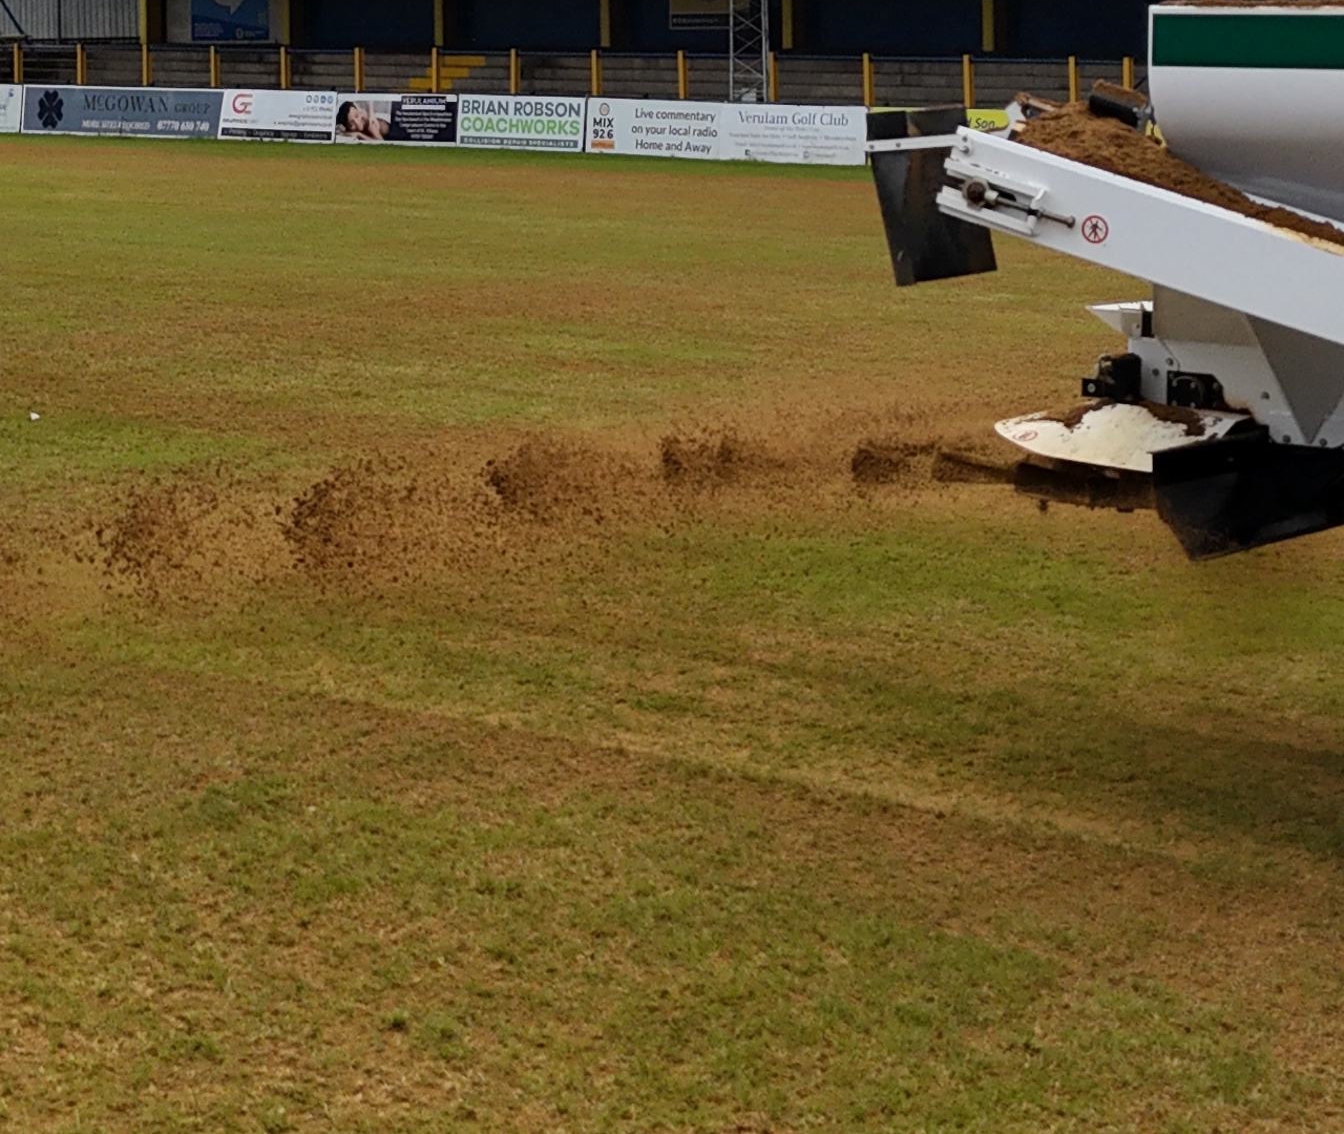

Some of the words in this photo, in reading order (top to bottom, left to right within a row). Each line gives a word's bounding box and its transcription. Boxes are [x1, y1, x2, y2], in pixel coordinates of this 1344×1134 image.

[83, 94, 169, 113] McGOWAN
[461, 100, 509, 116] BRIAN
[514, 101, 581, 118] ROBSON
[593, 117, 614, 129] MIX
[635, 108, 654, 119] Live
[656, 110, 716, 123] commentary
[738, 110, 788, 125] Verulam
[792, 111, 818, 126] Golf
[820, 112, 849, 127] Club
[974, 117, 995, 129] Son
[460, 117, 581, 137] COACHWORKS
[631, 126, 643, 134] on
[645, 126, 667, 136] your
[669, 125, 691, 136] local
[692, 127, 718, 138] radio
[463, 137, 501, 145] COLLISION
[635, 139, 662, 151] Home
[665, 141, 683, 152] and
[684, 142, 712, 155] Away
